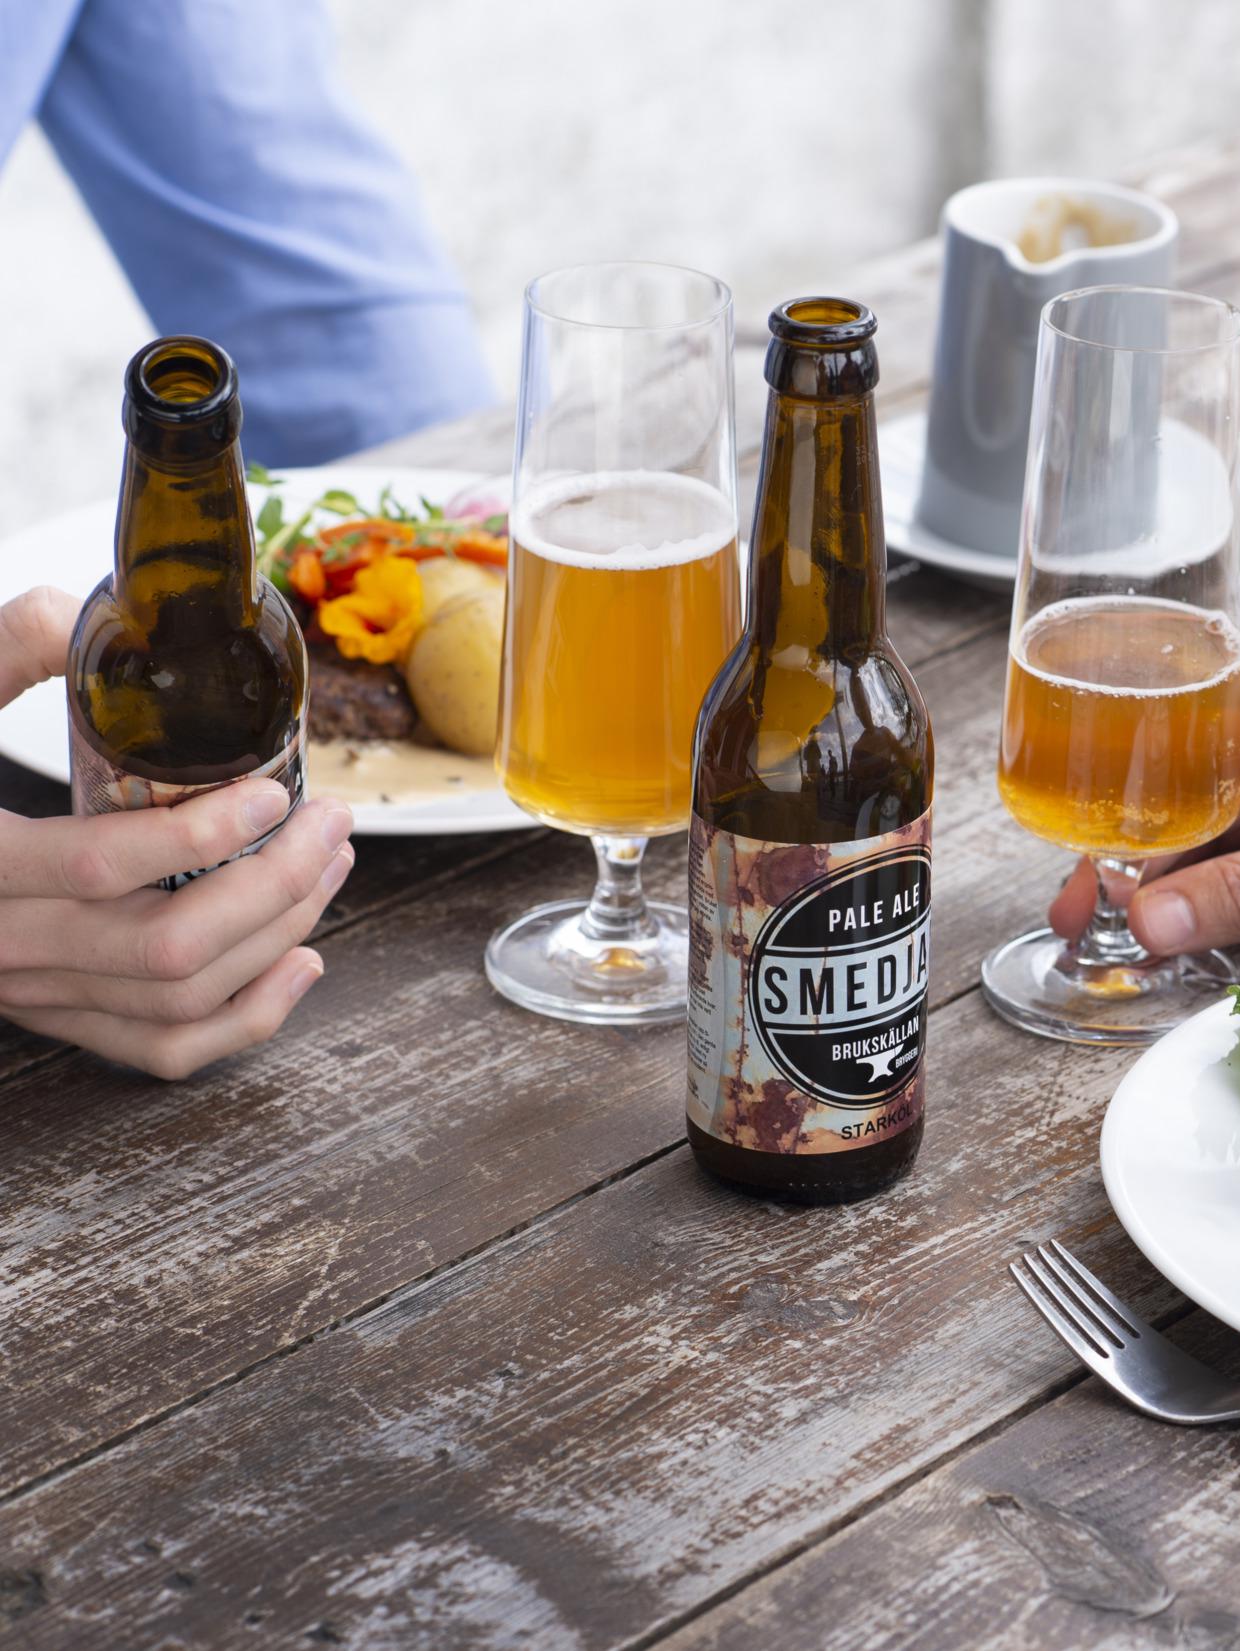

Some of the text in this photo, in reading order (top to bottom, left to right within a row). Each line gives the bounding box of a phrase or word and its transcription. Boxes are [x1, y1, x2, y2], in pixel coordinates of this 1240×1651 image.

[829, 882, 920, 933] PALE ALE
[832, 1015, 919, 1062] BRUKSKÄLLAN
